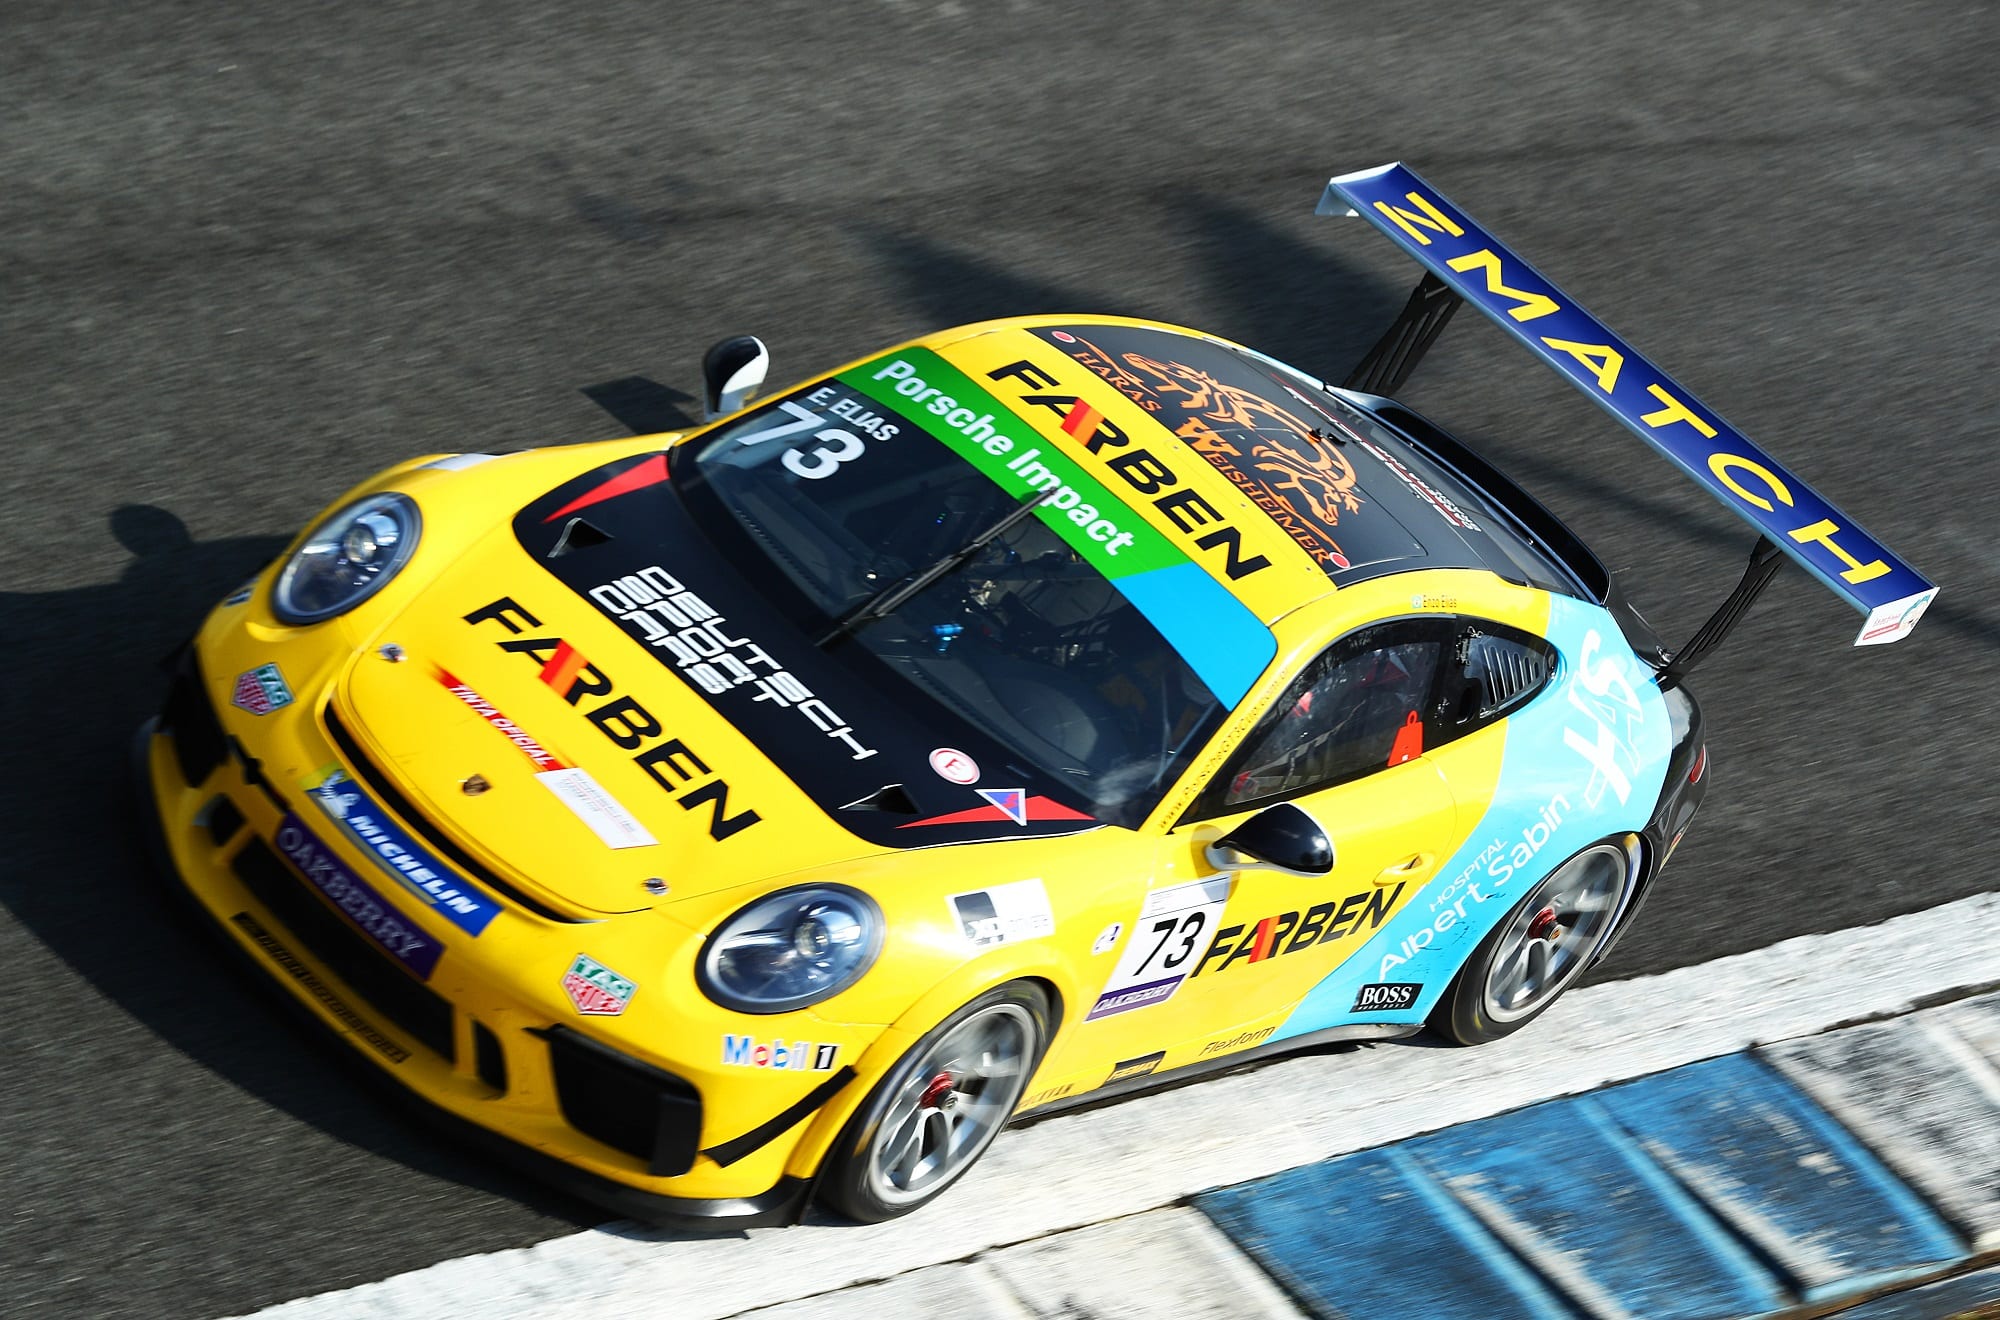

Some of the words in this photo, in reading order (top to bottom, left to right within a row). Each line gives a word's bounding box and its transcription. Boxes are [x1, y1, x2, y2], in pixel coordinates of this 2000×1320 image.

[806, 386, 837, 407] E.
[828, 398, 900, 441] ELIAS
[1072, 351, 1163, 411] HARAS
[1373, 192, 1892, 586] ZMATCH
[735, 401, 866, 480] 73
[872, 360, 1014, 456] Porsche
[1006, 448, 1134, 556] Impact
[986, 359, 1273, 580] FARBEN
[1175, 416, 1331, 565] WEISHEIMER
[589, 585, 736, 695] CARS
[611, 576, 791, 708] SPORT
[636, 566, 878, 760] DEUTSCH
[449, 684, 498, 717] TINTA
[490, 717, 555, 766] OFICIAL
[461, 596, 763, 842] FARBEN
[276, 827, 426, 958] OAKBERRY
[348, 815, 481, 914] MICHELIN
[1378, 882, 1490, 982] Albert
[1488, 793, 1571, 887] Sabin
[1428, 838, 1508, 912] HOSPITAL
[1133, 911, 1206, 977] 73
[1189, 881, 1407, 978] FARBEN
[1198, 1026, 1275, 1057] Flexform
[1360, 986, 1412, 1006] BOSS
[723, 1035, 809, 1070] Mobil
[816, 1045, 837, 1069] 1
